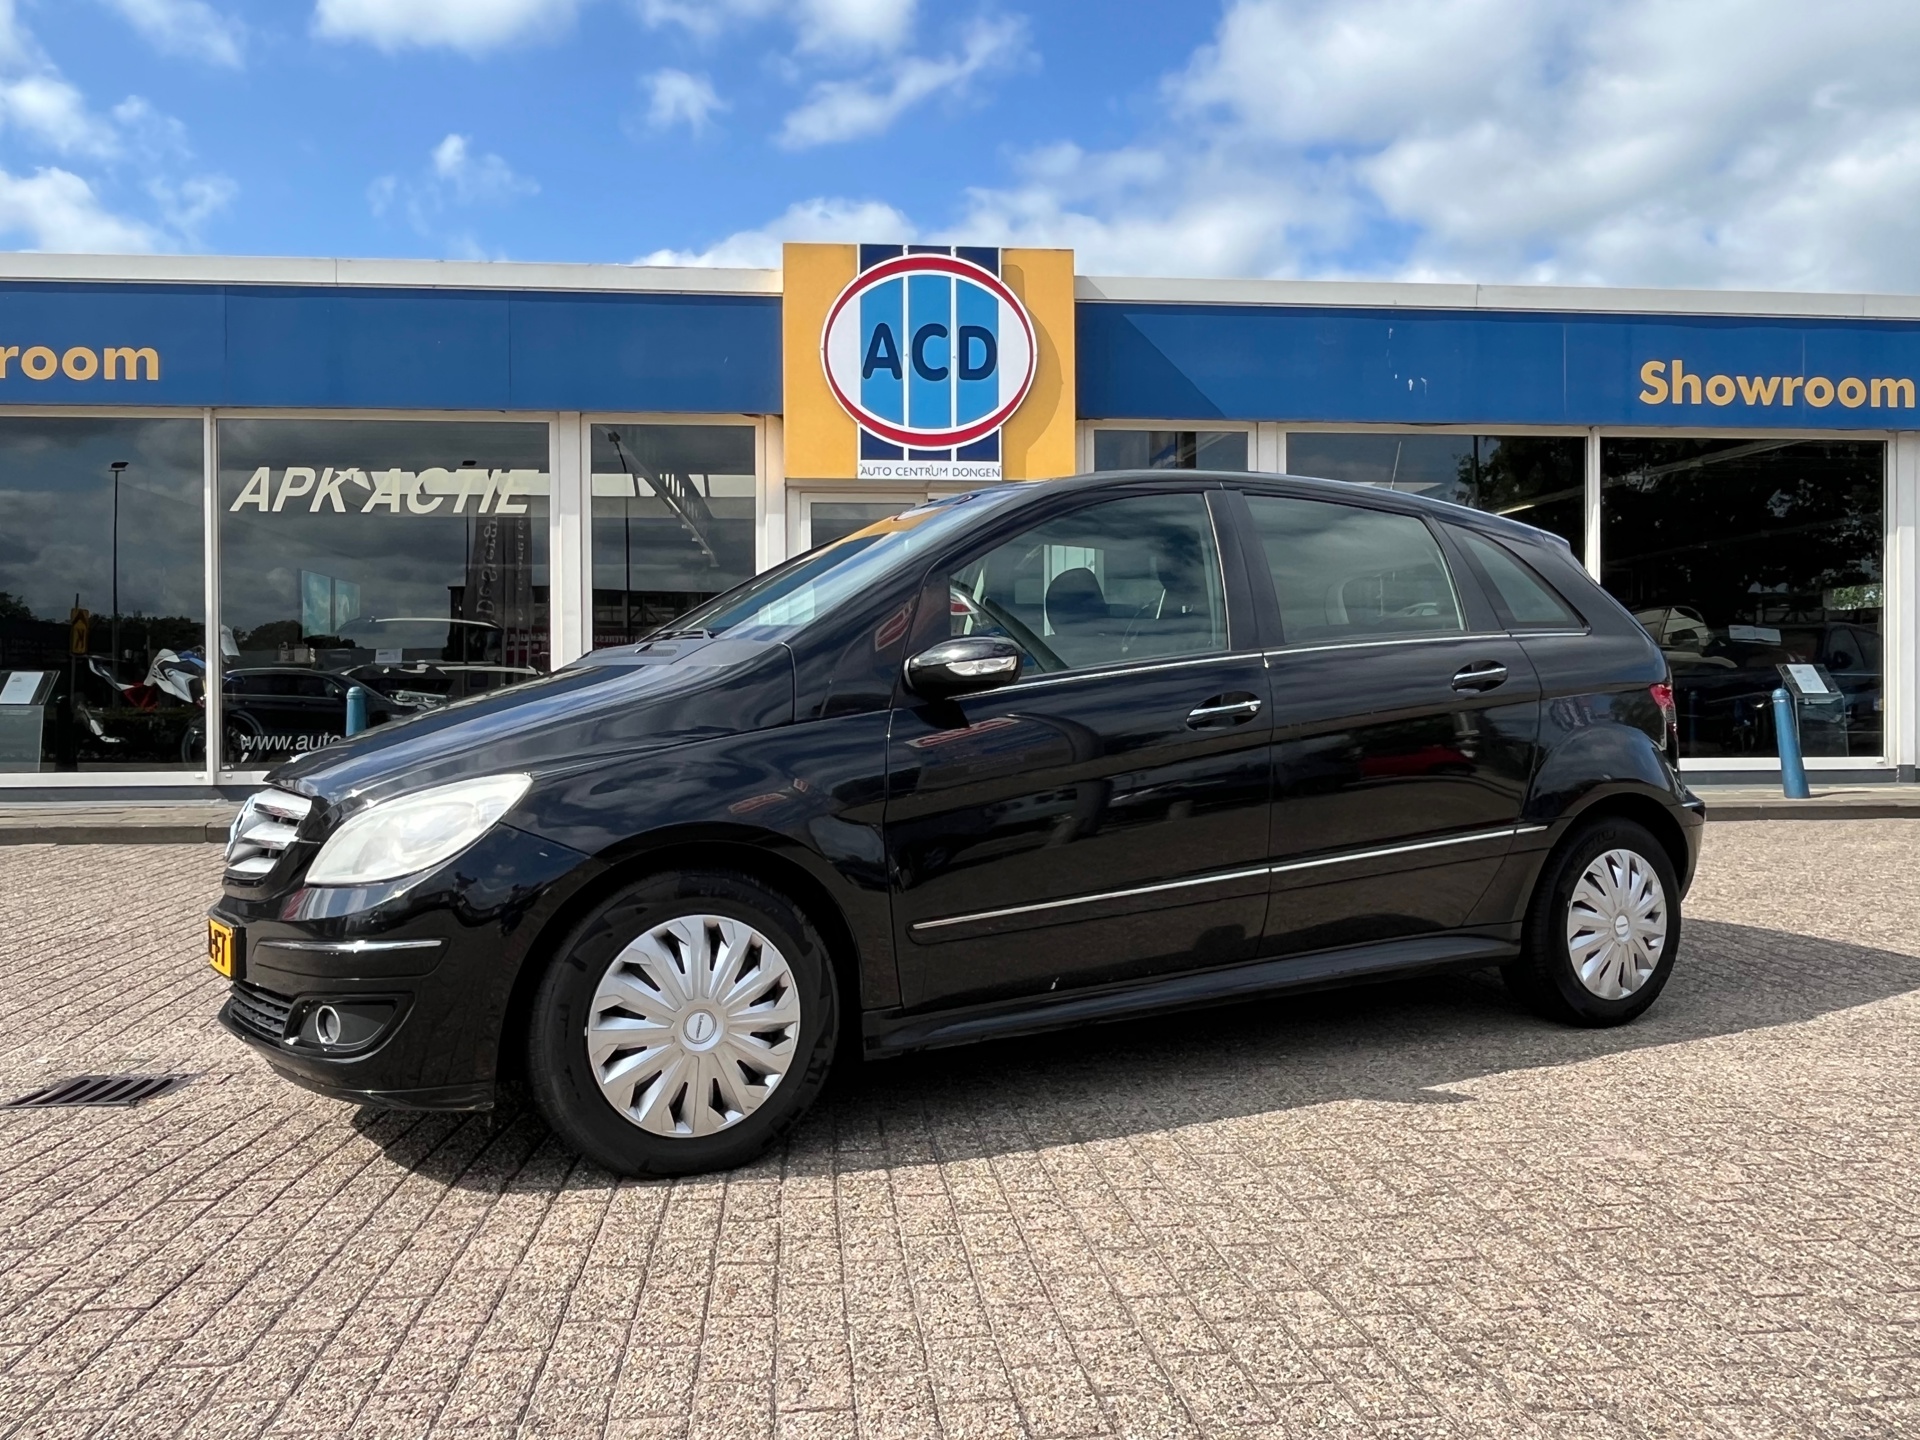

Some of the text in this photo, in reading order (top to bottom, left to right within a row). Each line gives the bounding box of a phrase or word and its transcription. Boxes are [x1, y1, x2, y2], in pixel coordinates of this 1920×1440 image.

[0, 346, 159, 381] room
[862, 322, 998, 381] ACD
[1639, 360, 1915, 408] Showroom
[229, 466, 540, 514] APK ACTIE
[860, 466, 1001, 478] AUTO CENTRUM DONGEN
